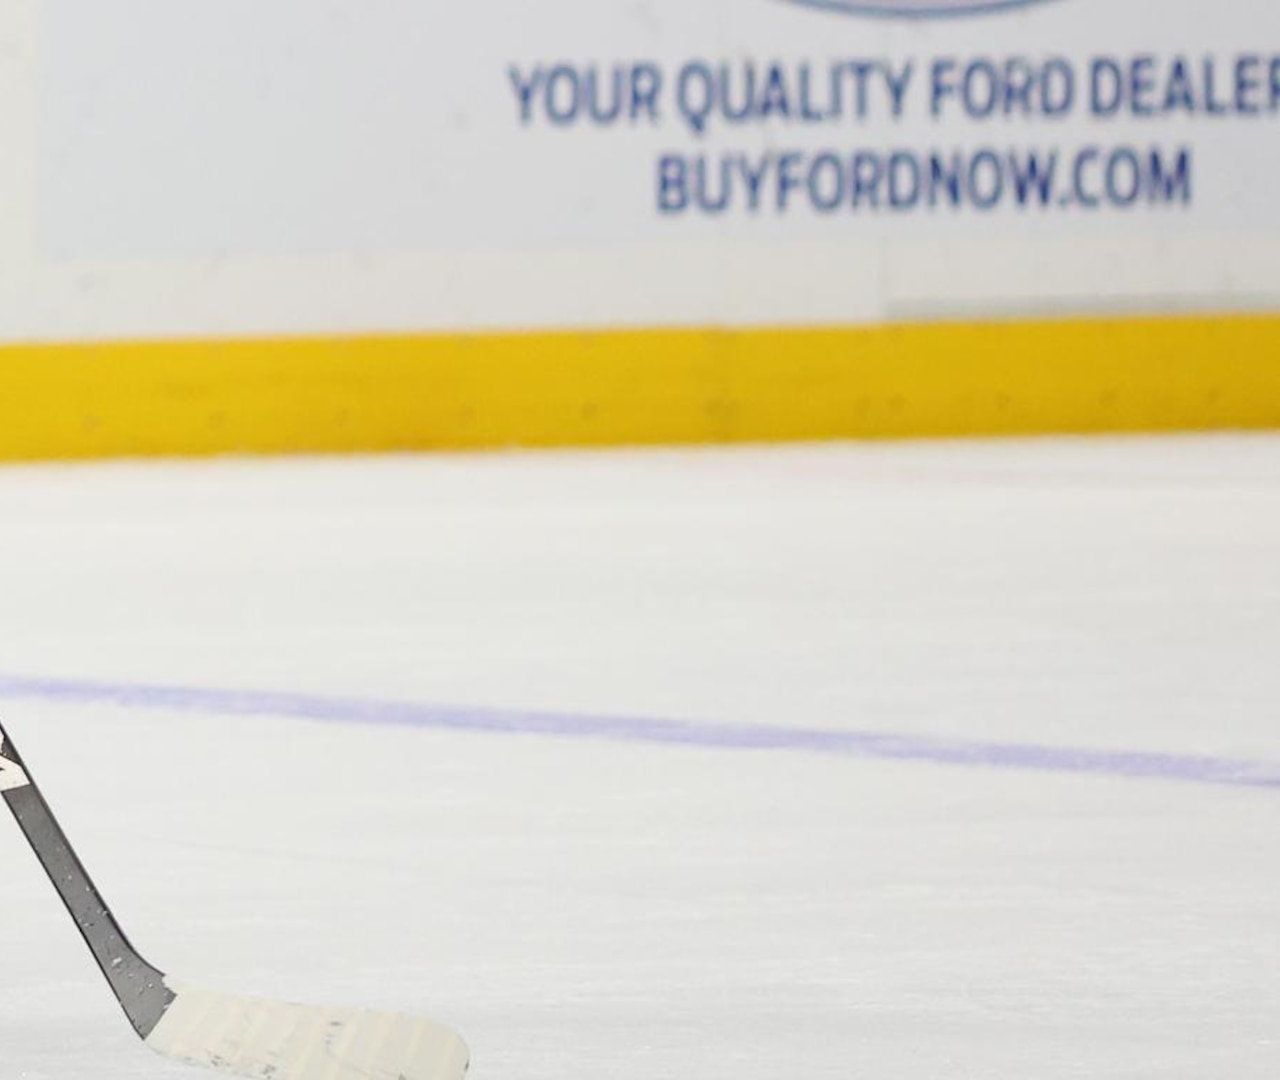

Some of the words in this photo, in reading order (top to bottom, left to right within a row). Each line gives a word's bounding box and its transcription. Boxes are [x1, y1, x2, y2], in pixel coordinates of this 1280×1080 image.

[507, 62, 663, 124] YOUR
[675, 58, 914, 136] QUALITY
[929, 55, 1074, 119] FORD
[656, 145, 1193, 214] BUYFORDNOW.COM
